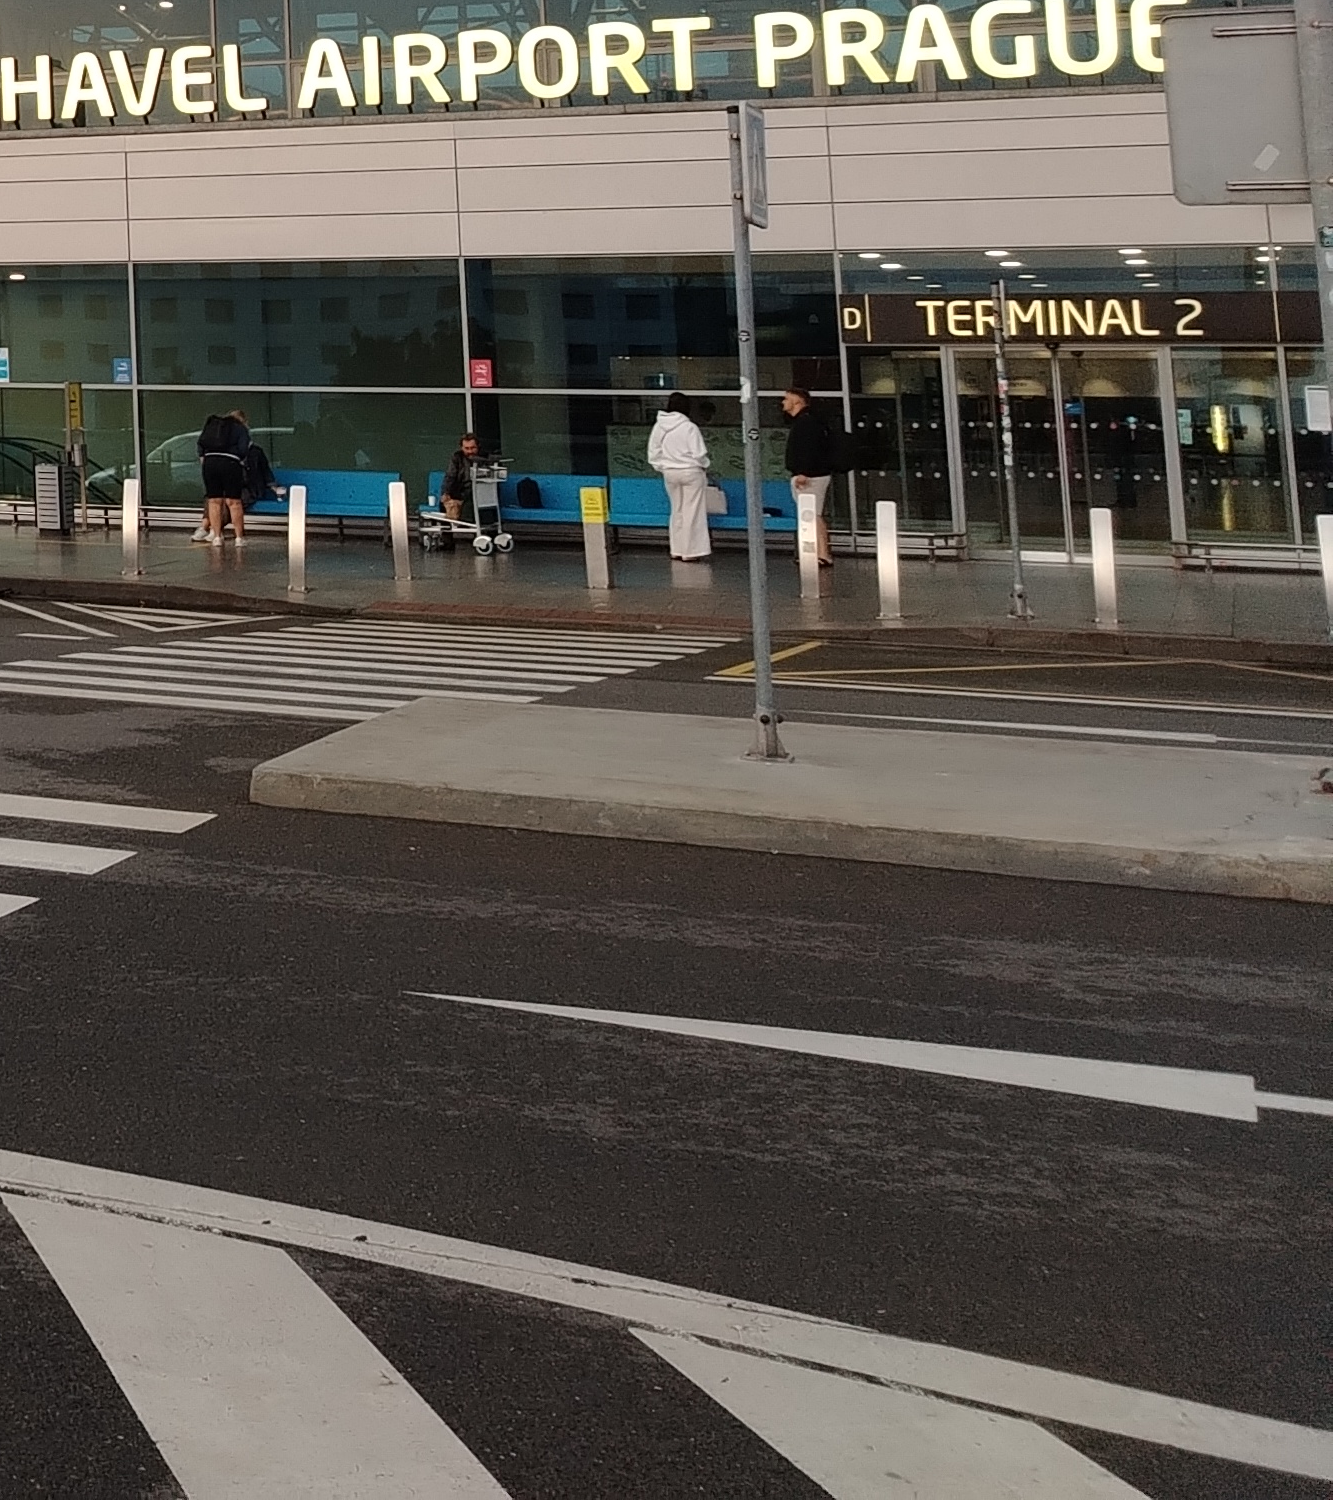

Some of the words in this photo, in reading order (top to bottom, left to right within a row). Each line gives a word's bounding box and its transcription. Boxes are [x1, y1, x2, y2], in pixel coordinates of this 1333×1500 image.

[0, 44, 267, 122] HAVEL
[297, 16, 711, 109] AIRPORT
[843, 307, 862, 330] D
[915, 299, 1160, 336] TERMINAL
[1174, 298, 1204, 336] 2
